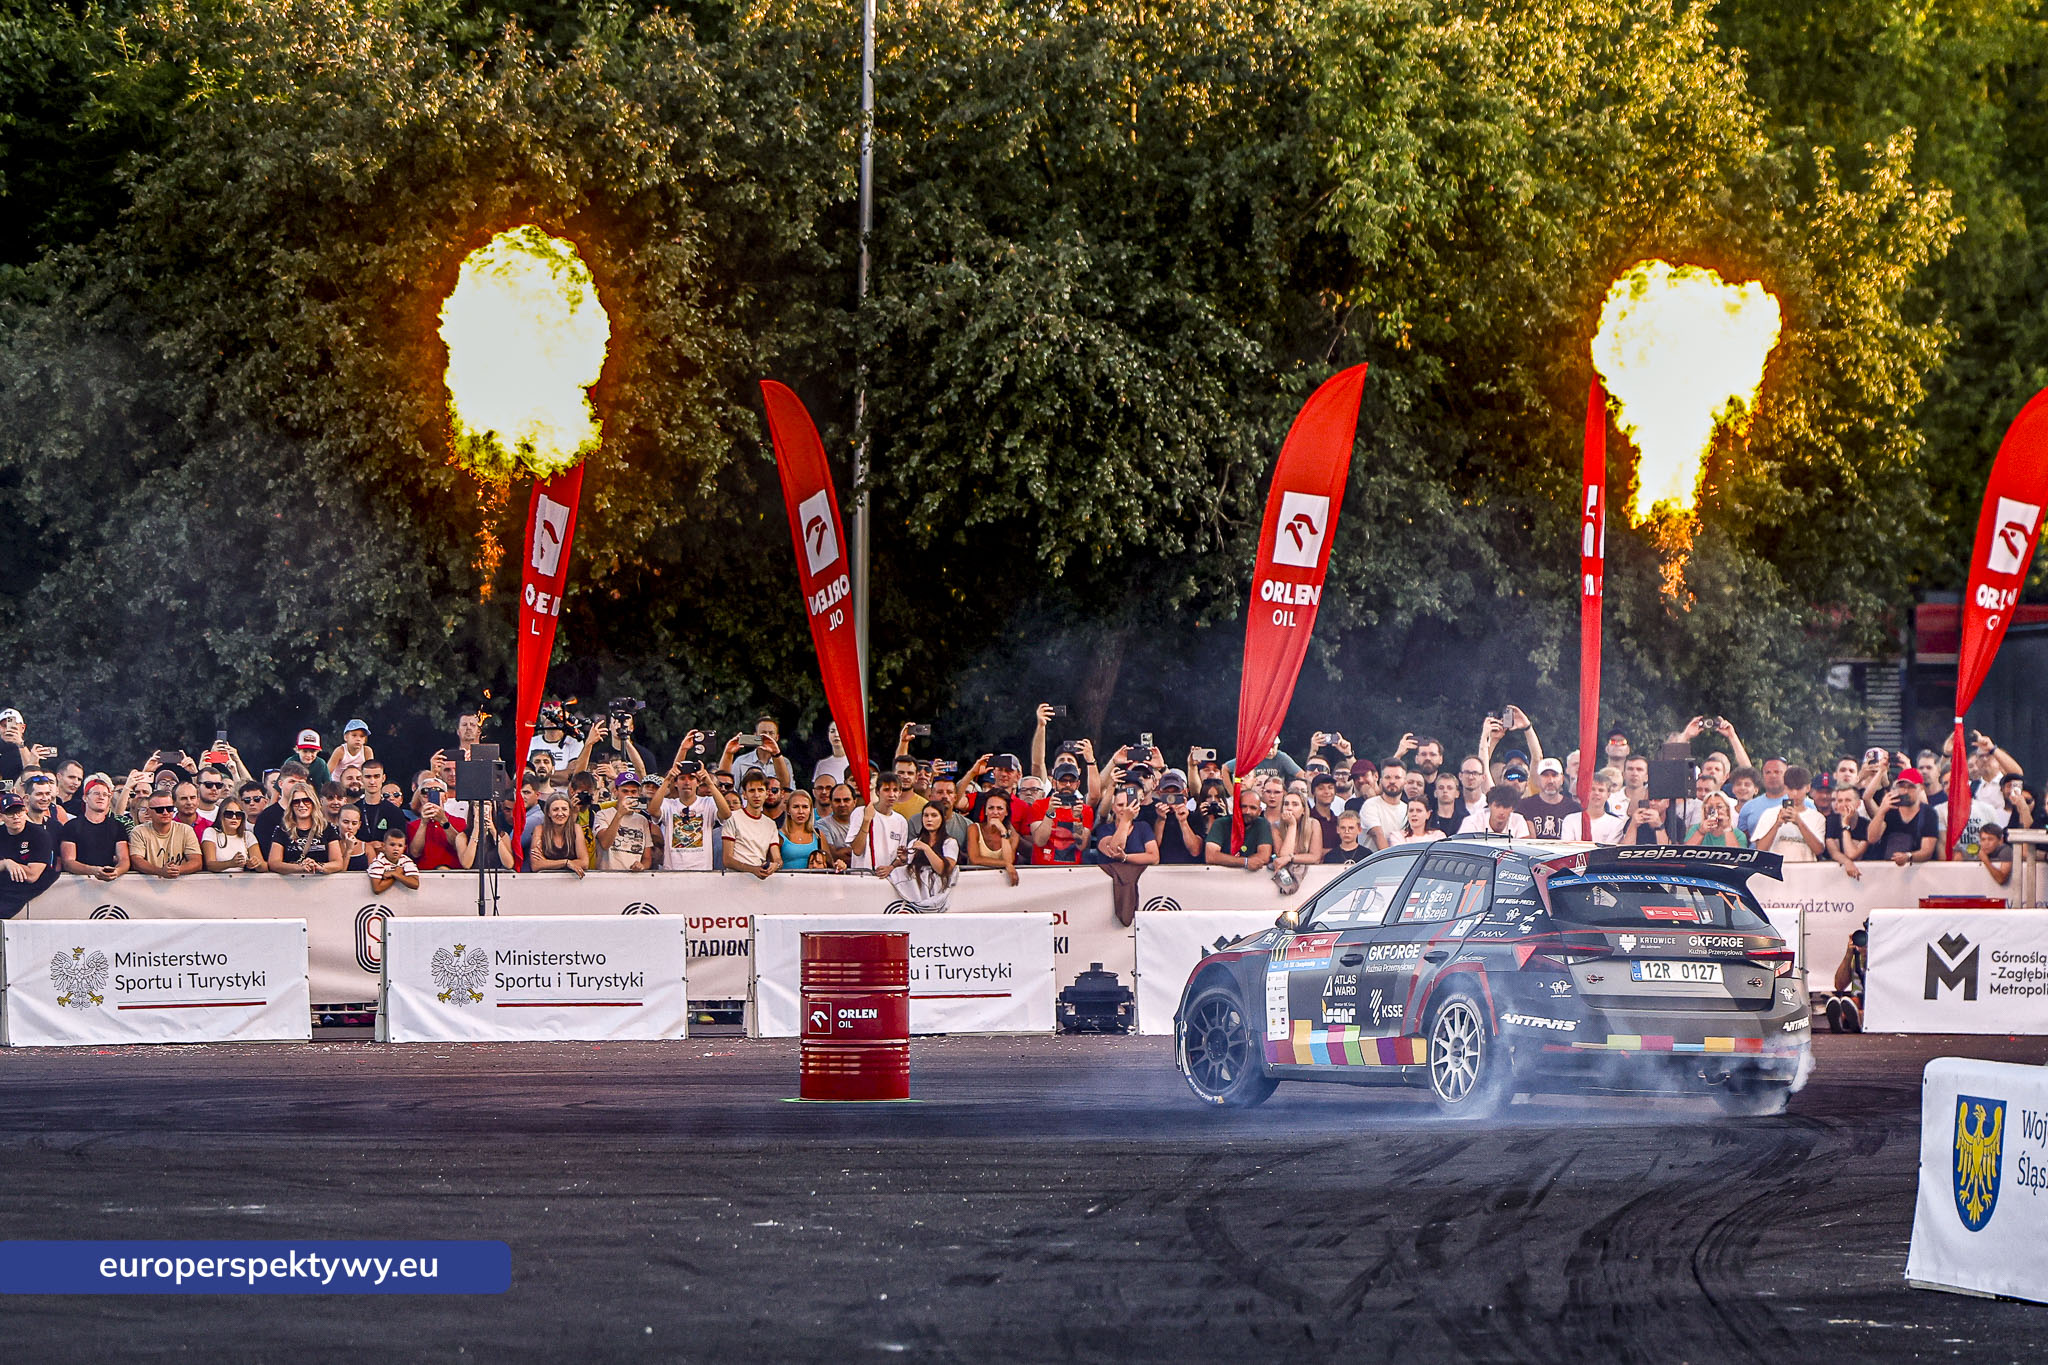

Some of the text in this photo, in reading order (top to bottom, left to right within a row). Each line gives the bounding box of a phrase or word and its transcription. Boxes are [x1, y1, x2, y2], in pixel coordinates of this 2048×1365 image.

[1261, 579, 1321, 606] ORLEN
[1272, 609, 1297, 627] OIL
[1617, 846, 1759, 863] szeja.com.pl
[1457, 879, 1488, 913] 17
[685, 939, 749, 957] TADION
[1640, 936, 1676, 945] KATOWICE
[1688, 935, 1744, 948] GKFORGE
[115, 951, 228, 968] Ministerstwo
[495, 949, 607, 966] Ministerstwo
[1368, 943, 1421, 961] GKFORGE
[925, 964, 929, 980] i
[934, 963, 1012, 983] Turystyki
[1334, 974, 1357, 985] ATLAS
[1645, 962, 1715, 981] 12R 0127
[115, 971, 266, 994] Sportu i Turystyki
[494, 971, 644, 992] Sportu i Turystyki
[1334, 986, 1357, 996] WARD
[837, 1008, 878, 1019] ORLEN
[1381, 1004, 1403, 1018] KSSE
[838, 1020, 854, 1029] OIL
[2022, 1109, 2048, 1149] Woj
[2017, 1150, 2048, 1196] Śląs
